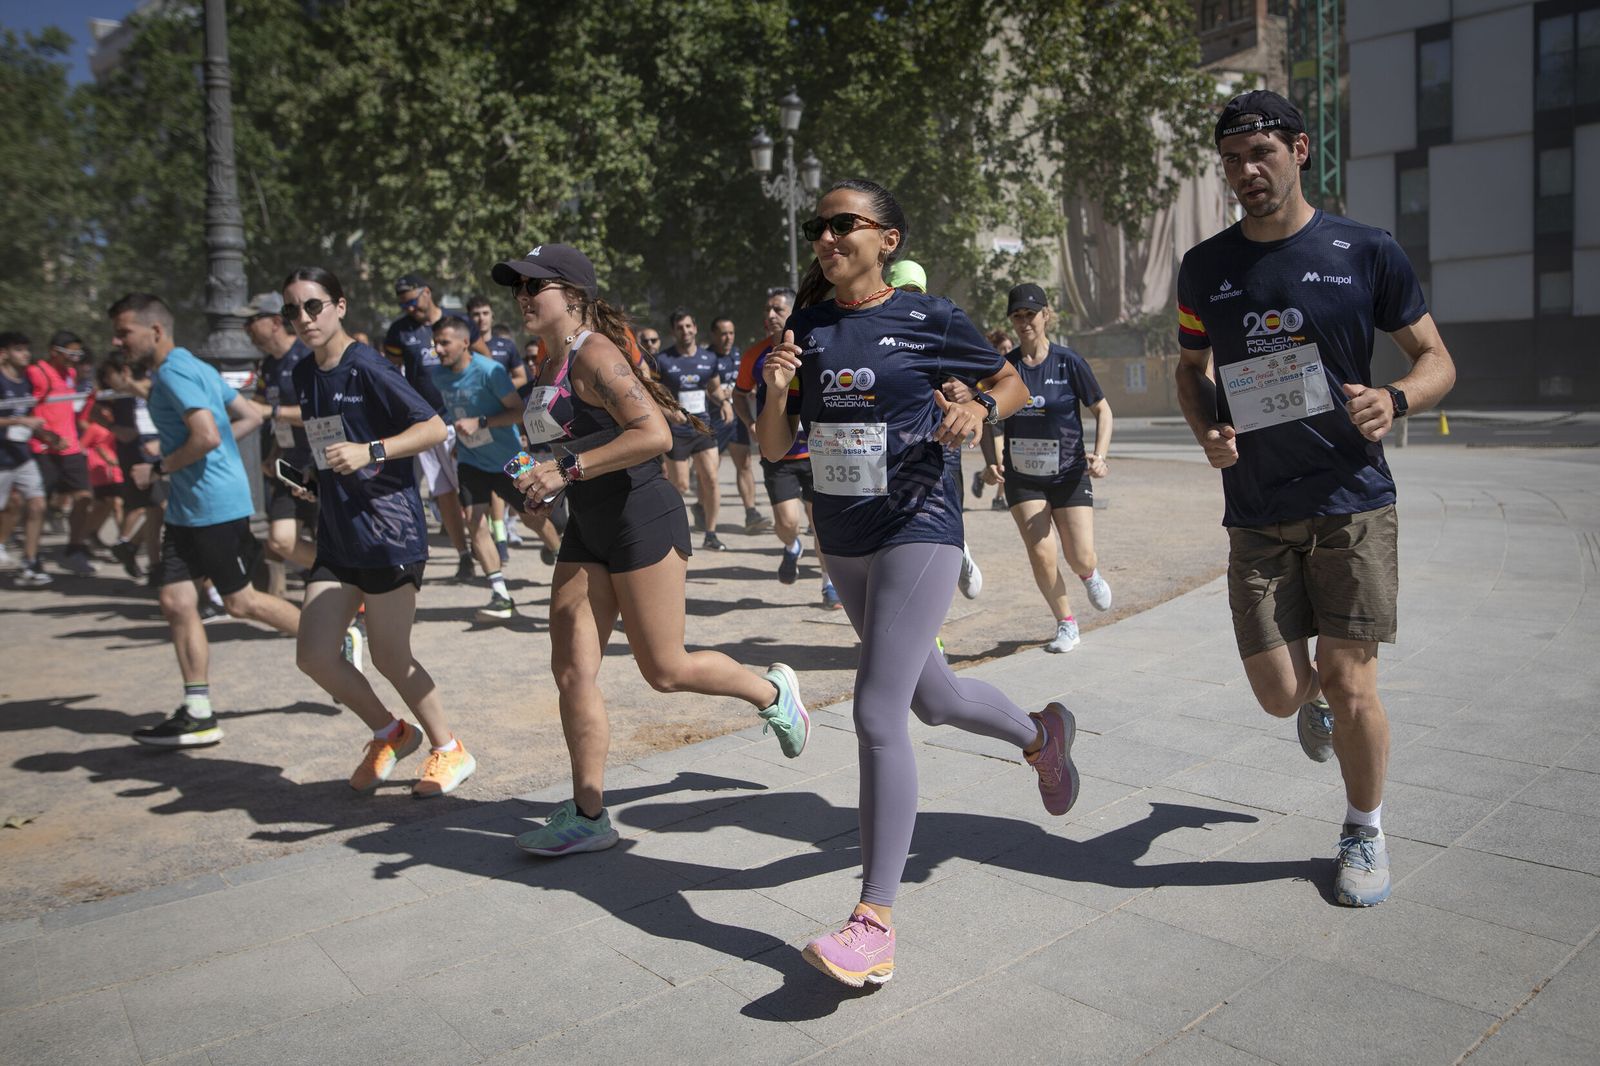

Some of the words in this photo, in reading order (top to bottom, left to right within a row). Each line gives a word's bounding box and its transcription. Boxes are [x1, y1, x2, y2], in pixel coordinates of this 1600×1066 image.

[1323, 275, 1352, 285] mupol
[1210, 289, 1243, 303] Santander
[1243, 307, 1304, 337] 200
[898, 341, 925, 351] mupol
[1246, 336, 1293, 347] POLICIA
[820, 367, 876, 393] 200
[1229, 376, 1254, 389] alsa
[822, 394, 865, 402] POLICIA
[1260, 390, 1304, 413] 336
[529, 419, 546, 434] 119
[1024, 460, 1046, 470] 507
[825, 465, 861, 483] 335
